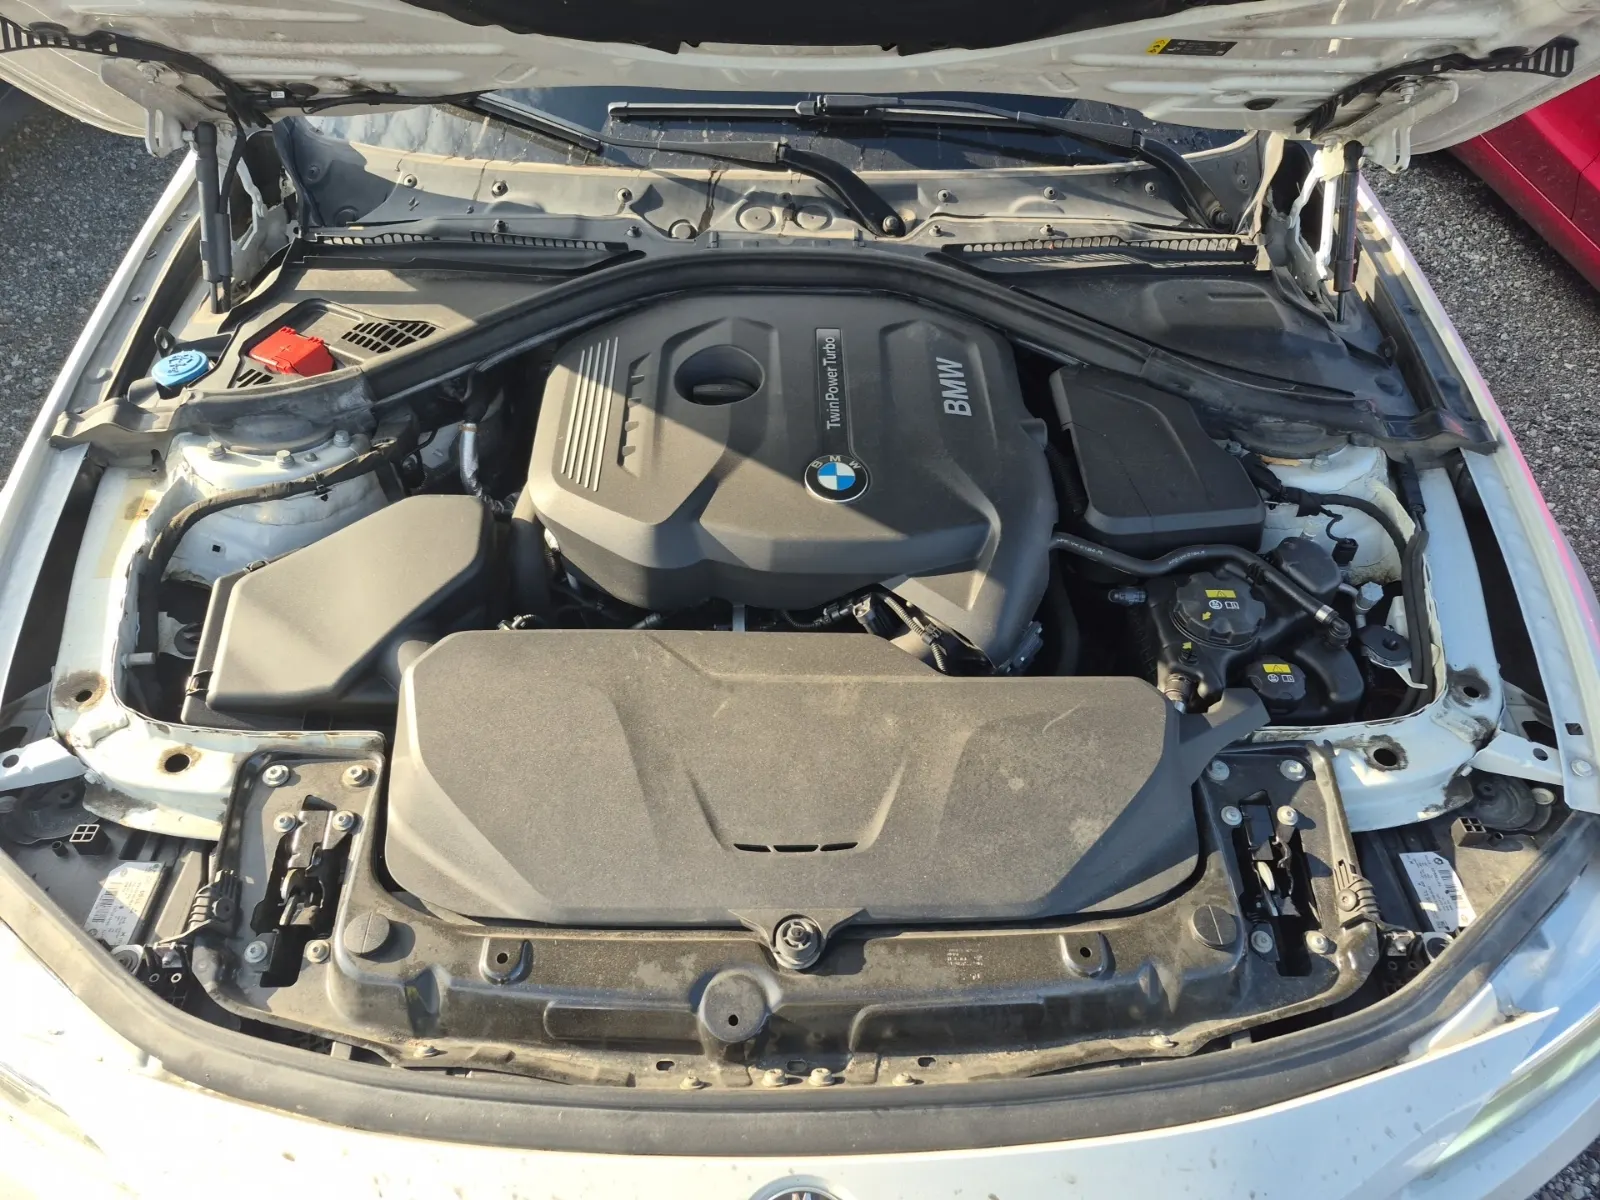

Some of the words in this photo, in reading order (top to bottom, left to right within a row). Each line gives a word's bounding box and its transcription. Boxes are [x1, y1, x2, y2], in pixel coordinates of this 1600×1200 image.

[823, 336, 837, 366] Turbo
[825, 366, 841, 430] TwinPower
[935, 356, 972, 417] BMW
[810, 455, 861, 469] BMW
